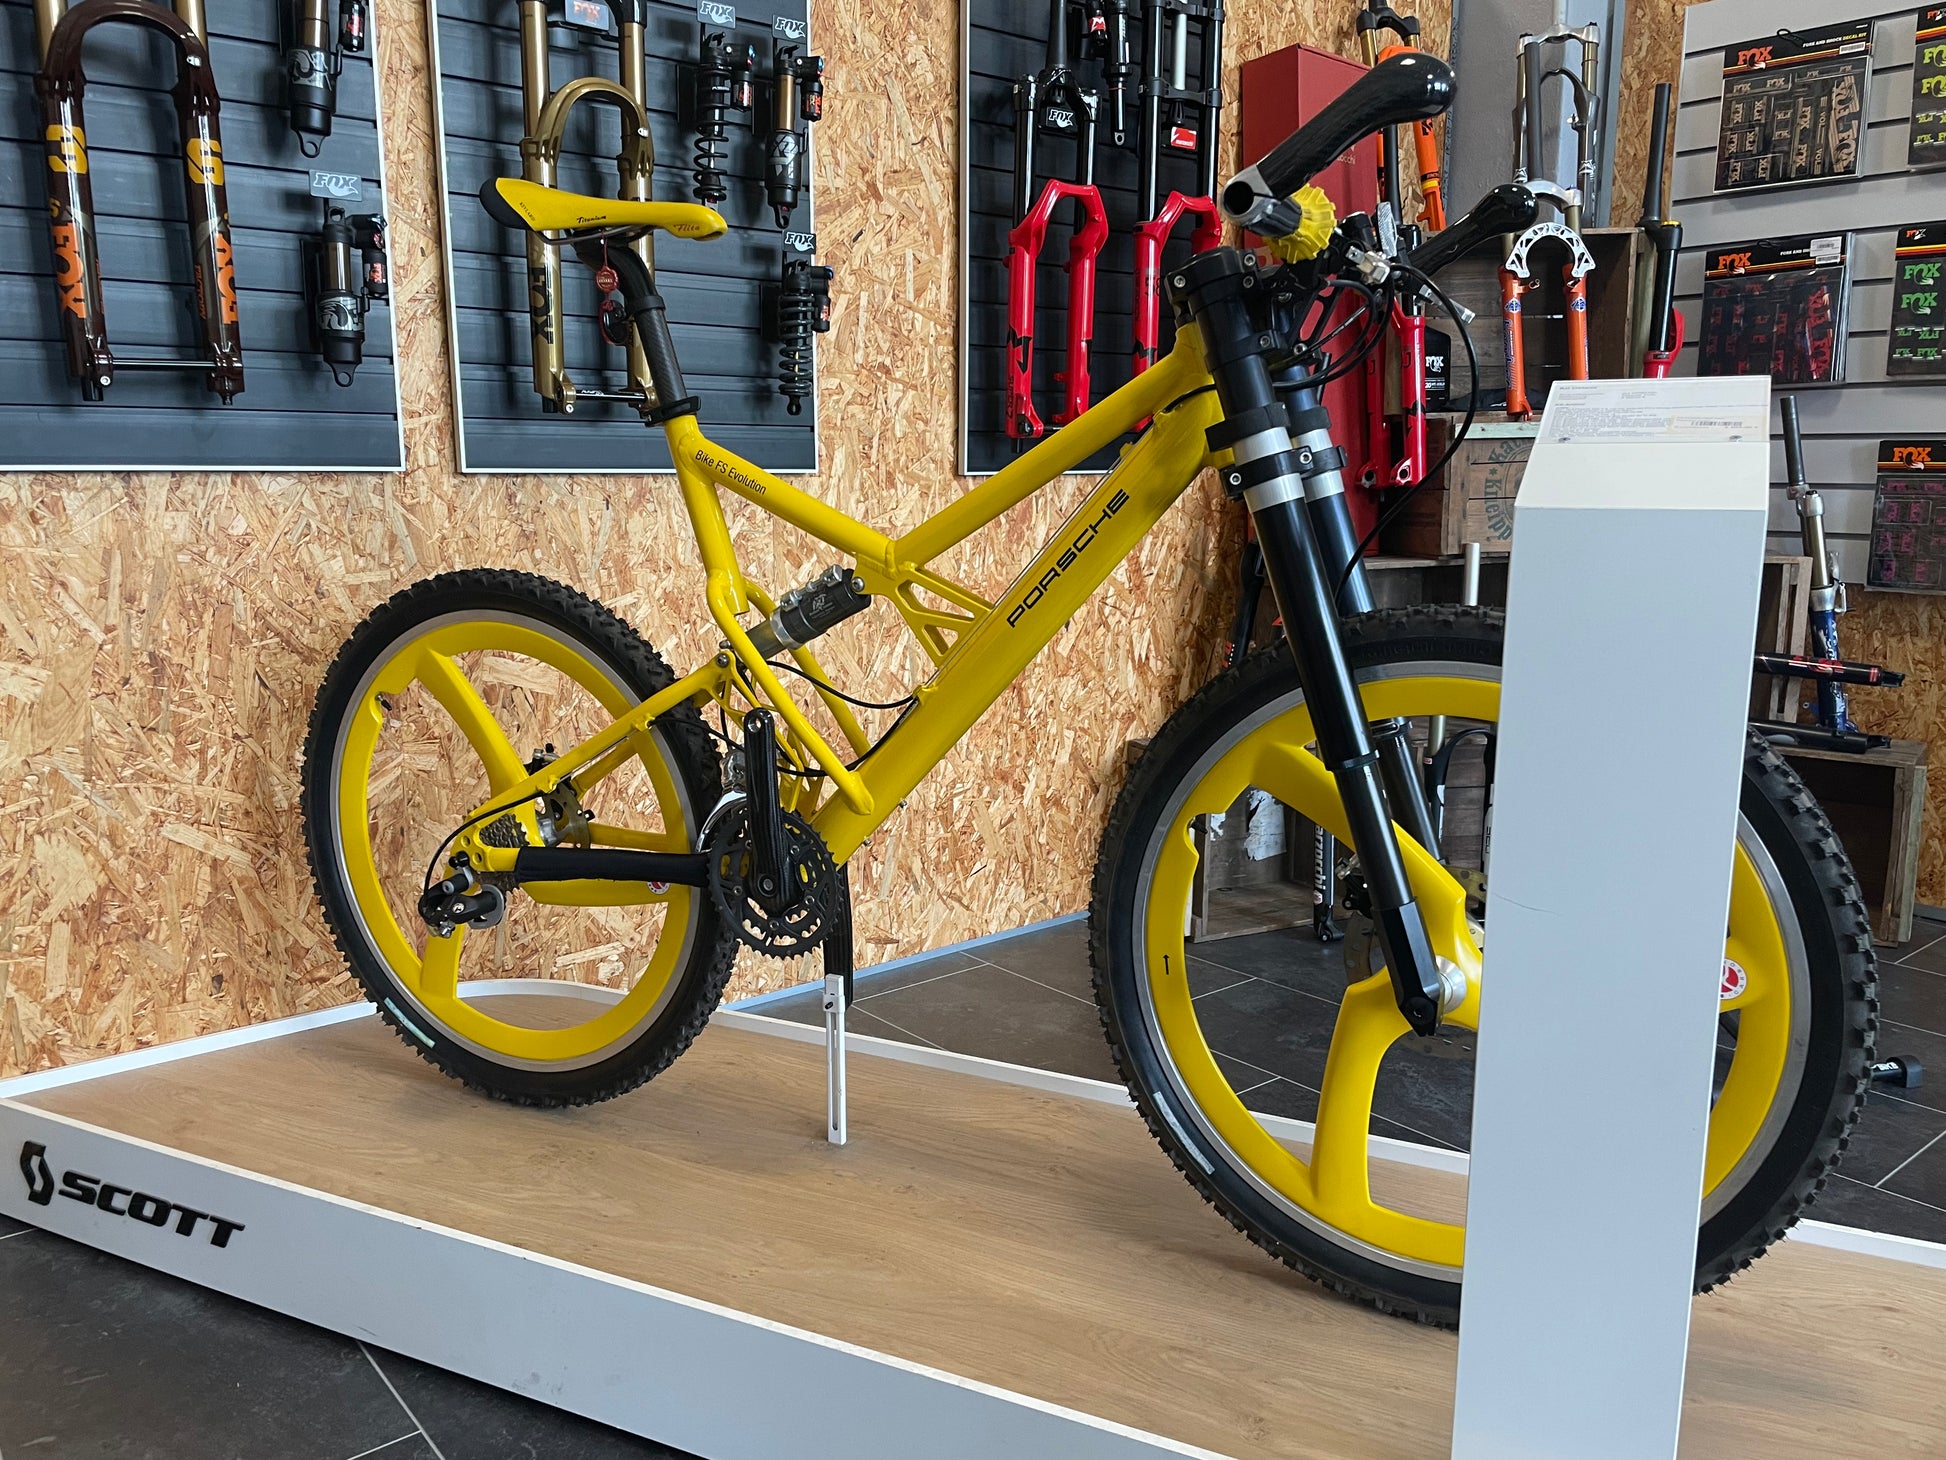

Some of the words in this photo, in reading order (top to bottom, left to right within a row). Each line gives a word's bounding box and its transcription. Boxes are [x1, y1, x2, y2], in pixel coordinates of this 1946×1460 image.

[700, 1, 733, 24] FOX
[775, 17, 806, 39] FOX
[1738, 46, 1773, 69] FOX
[1923, 45, 1946, 67] FO
[1767, 78, 1785, 88] FOX
[1921, 75, 1946, 98] FO
[1048, 108, 1074, 128] FOX
[313, 172, 359, 197] FOX
[577, 214, 607, 224] Titanium
[785, 231, 814, 252] FOX
[51, 222, 87, 319] FOX
[1718, 252, 1752, 275] FOX
[1904, 262, 1942, 286] FOX
[195, 264, 208, 321] FACTORY
[1901, 292, 1938, 315] FOX
[531, 267, 554, 345] FOX
[1425, 355, 1444, 373] FOX
[1893, 447, 1932, 471] FOX
[695, 449, 715, 467] Bike
[715, 460, 728, 474] FS
[727, 467, 767, 496] Evolution
[1007, 488, 1131, 628] PORSCHE
[1314, 824, 1326, 890] arzocchi
[58, 1169, 246, 1249] SCOTT
